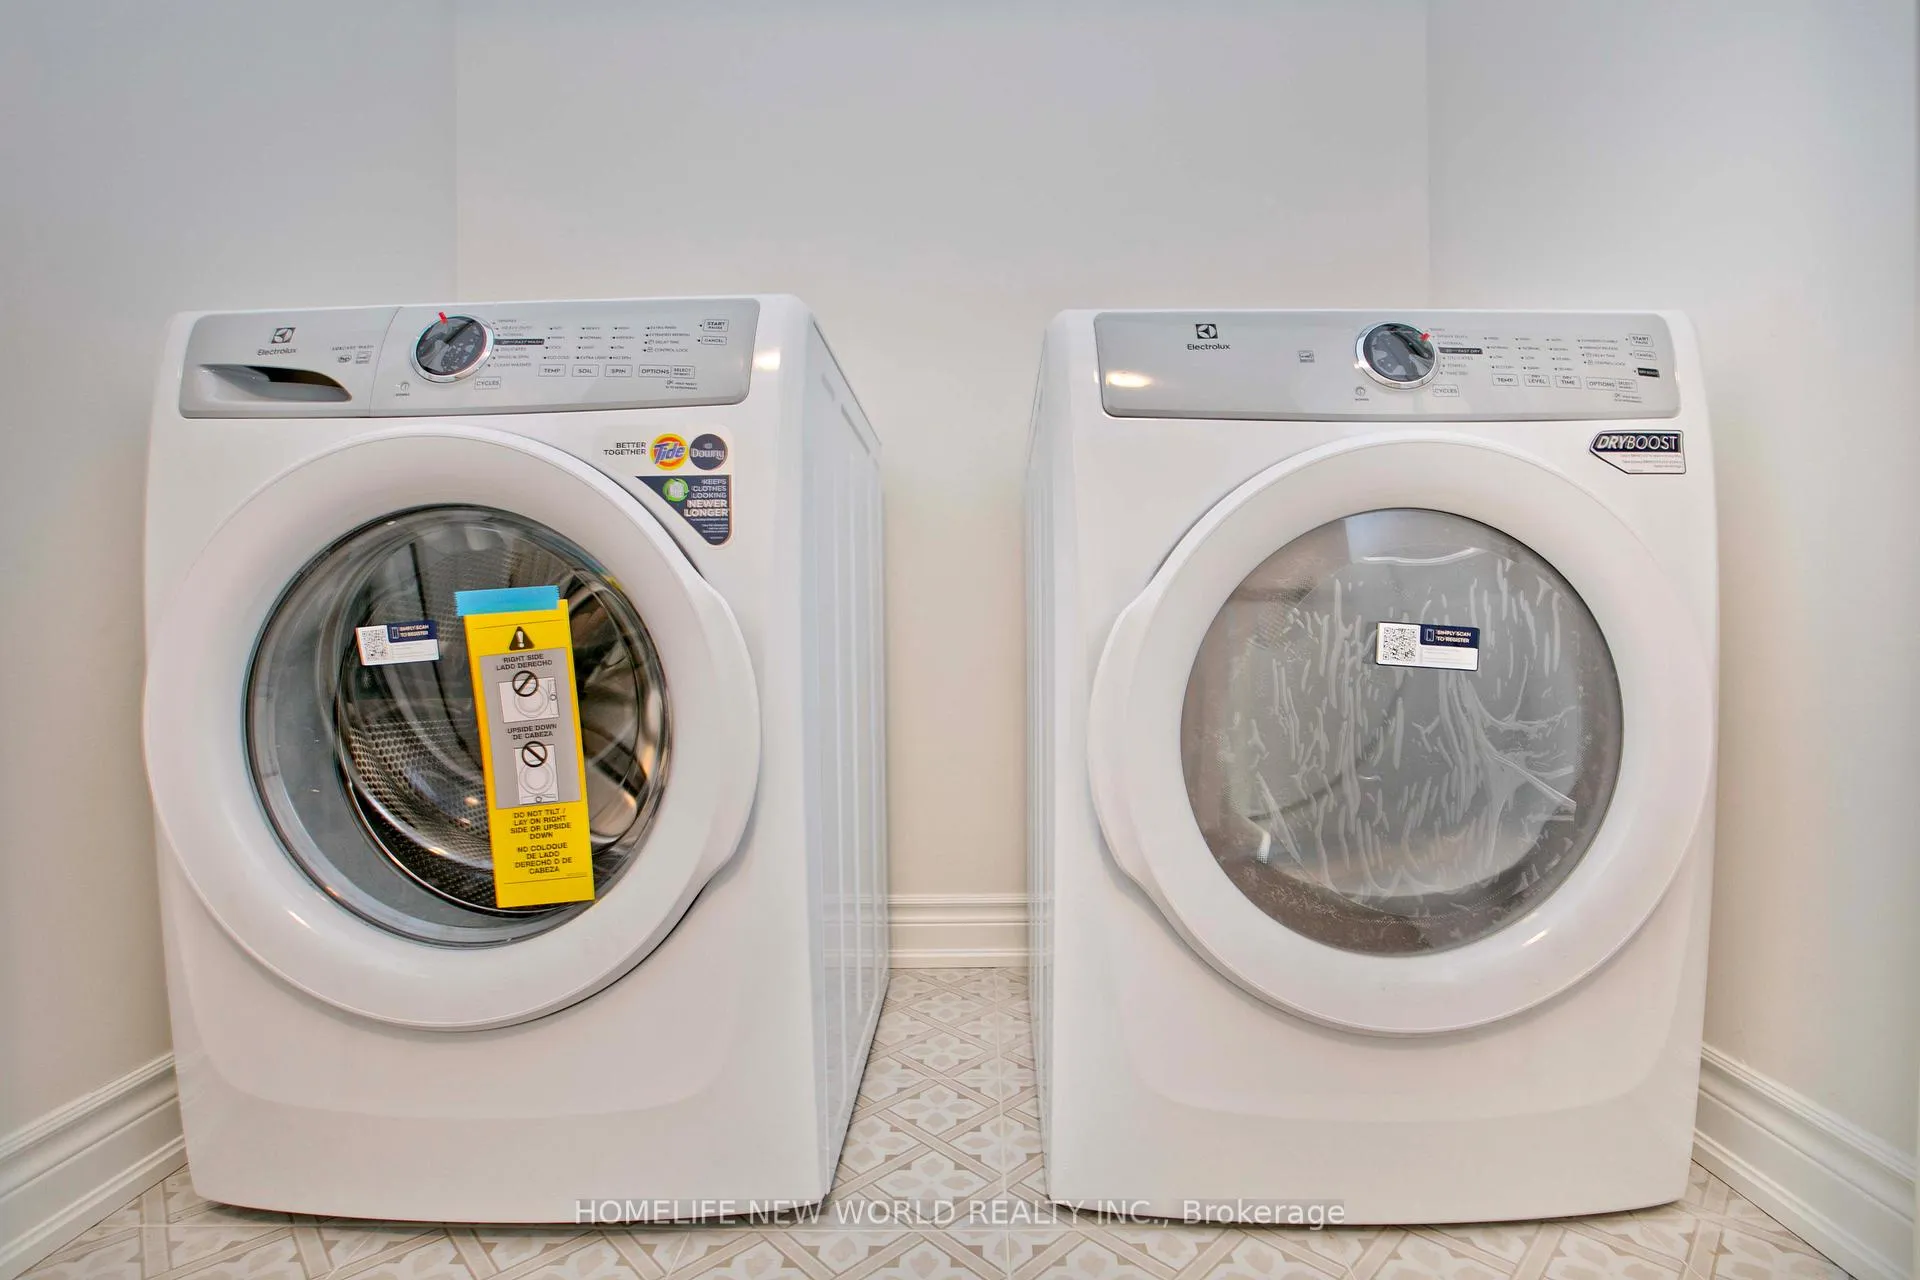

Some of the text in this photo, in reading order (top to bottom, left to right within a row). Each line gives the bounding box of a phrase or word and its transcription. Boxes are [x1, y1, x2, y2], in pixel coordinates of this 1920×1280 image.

[257, 347, 297, 356] Electrolux
[1187, 343, 1231, 351] Electrolux
[1597, 435, 1677, 450] DRYBOOST
[654, 443, 685, 464] Tide
[692, 448, 724, 460] Downy
[686, 500, 727, 508] NEWER
[684, 508, 729, 517] LONGER
[496, 660, 552, 671] LADO DERECHO
[507, 723, 557, 734] UPSIDE DOWN
[524, 731, 553, 739] CABEZA
[543, 815, 566, 824] RIGHT
[543, 822, 571, 831] UPSIDE
[529, 832, 553, 840] DOWN
[530, 843, 568, 852] COLOQUE
[514, 860, 551, 869] DERECHO
[529, 866, 560, 875] CABEZA
